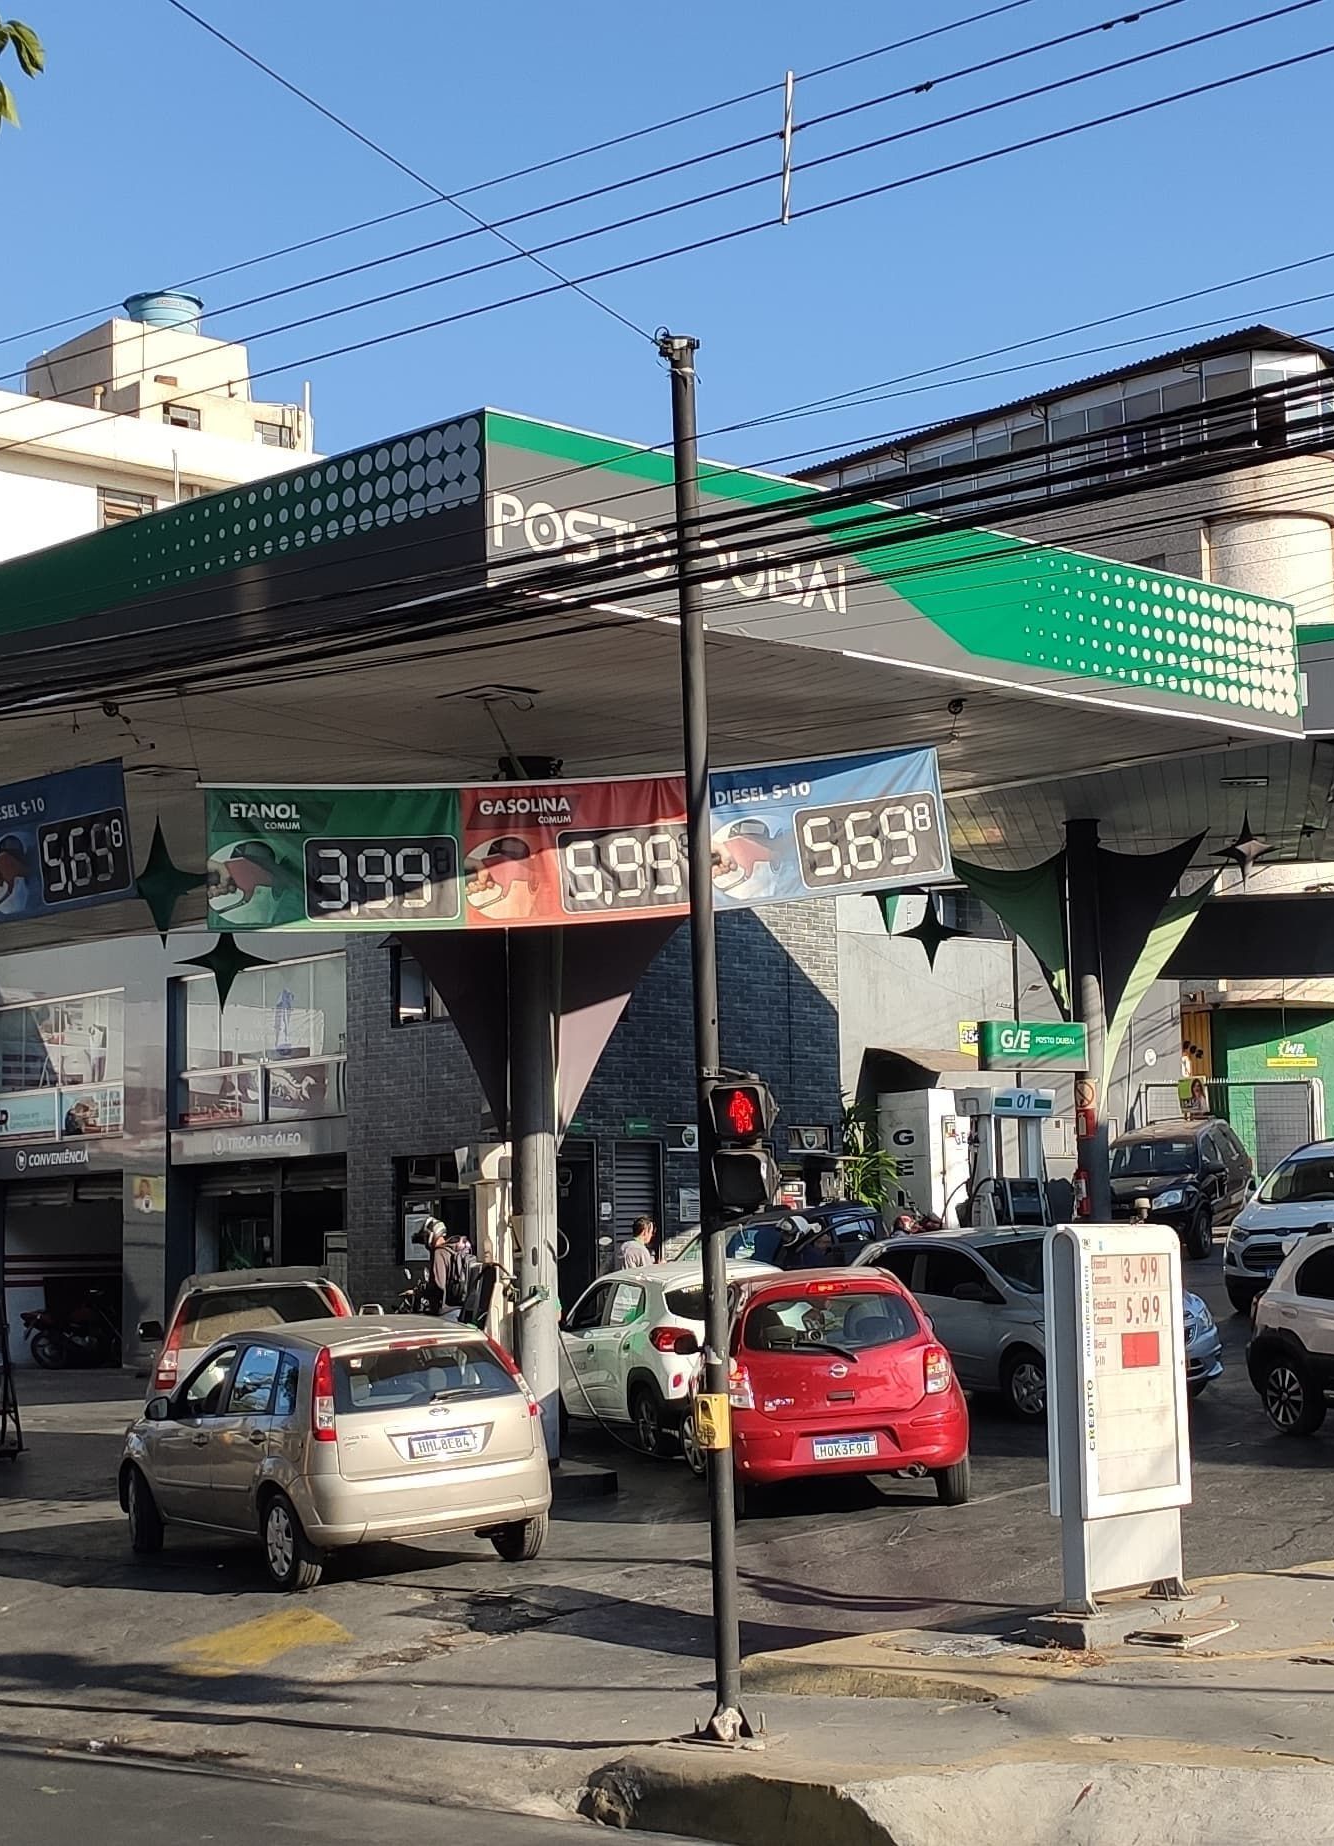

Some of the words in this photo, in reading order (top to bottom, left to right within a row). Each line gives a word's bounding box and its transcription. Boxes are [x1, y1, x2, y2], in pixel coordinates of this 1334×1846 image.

[493, 491, 679, 579] POSTO
[715, 786, 768, 806] DIESEL
[772, 781, 811, 799] S-10
[20, 798, 45, 817] S-10
[230, 803, 301, 819] ETANOL
[479, 797, 571, 816] GASOLINA
[264, 821, 301, 831] COMUM
[538, 815, 572, 824] COMUM
[317, 847, 432, 917] 3,99
[1000, 1029, 1031, 1049] G/E
[1017, 1094, 1032, 1108] 01
[227, 1136, 258, 1149] TROCA
[260, 1135, 273, 1147] DE
[275, 1131, 301, 1146] ÓLEO
[28, 1147, 89, 1167] CONVENIÊNCIA
[1123, 1256, 1159, 1285] 3.99
[1125, 1295, 1161, 1325] 5.99
